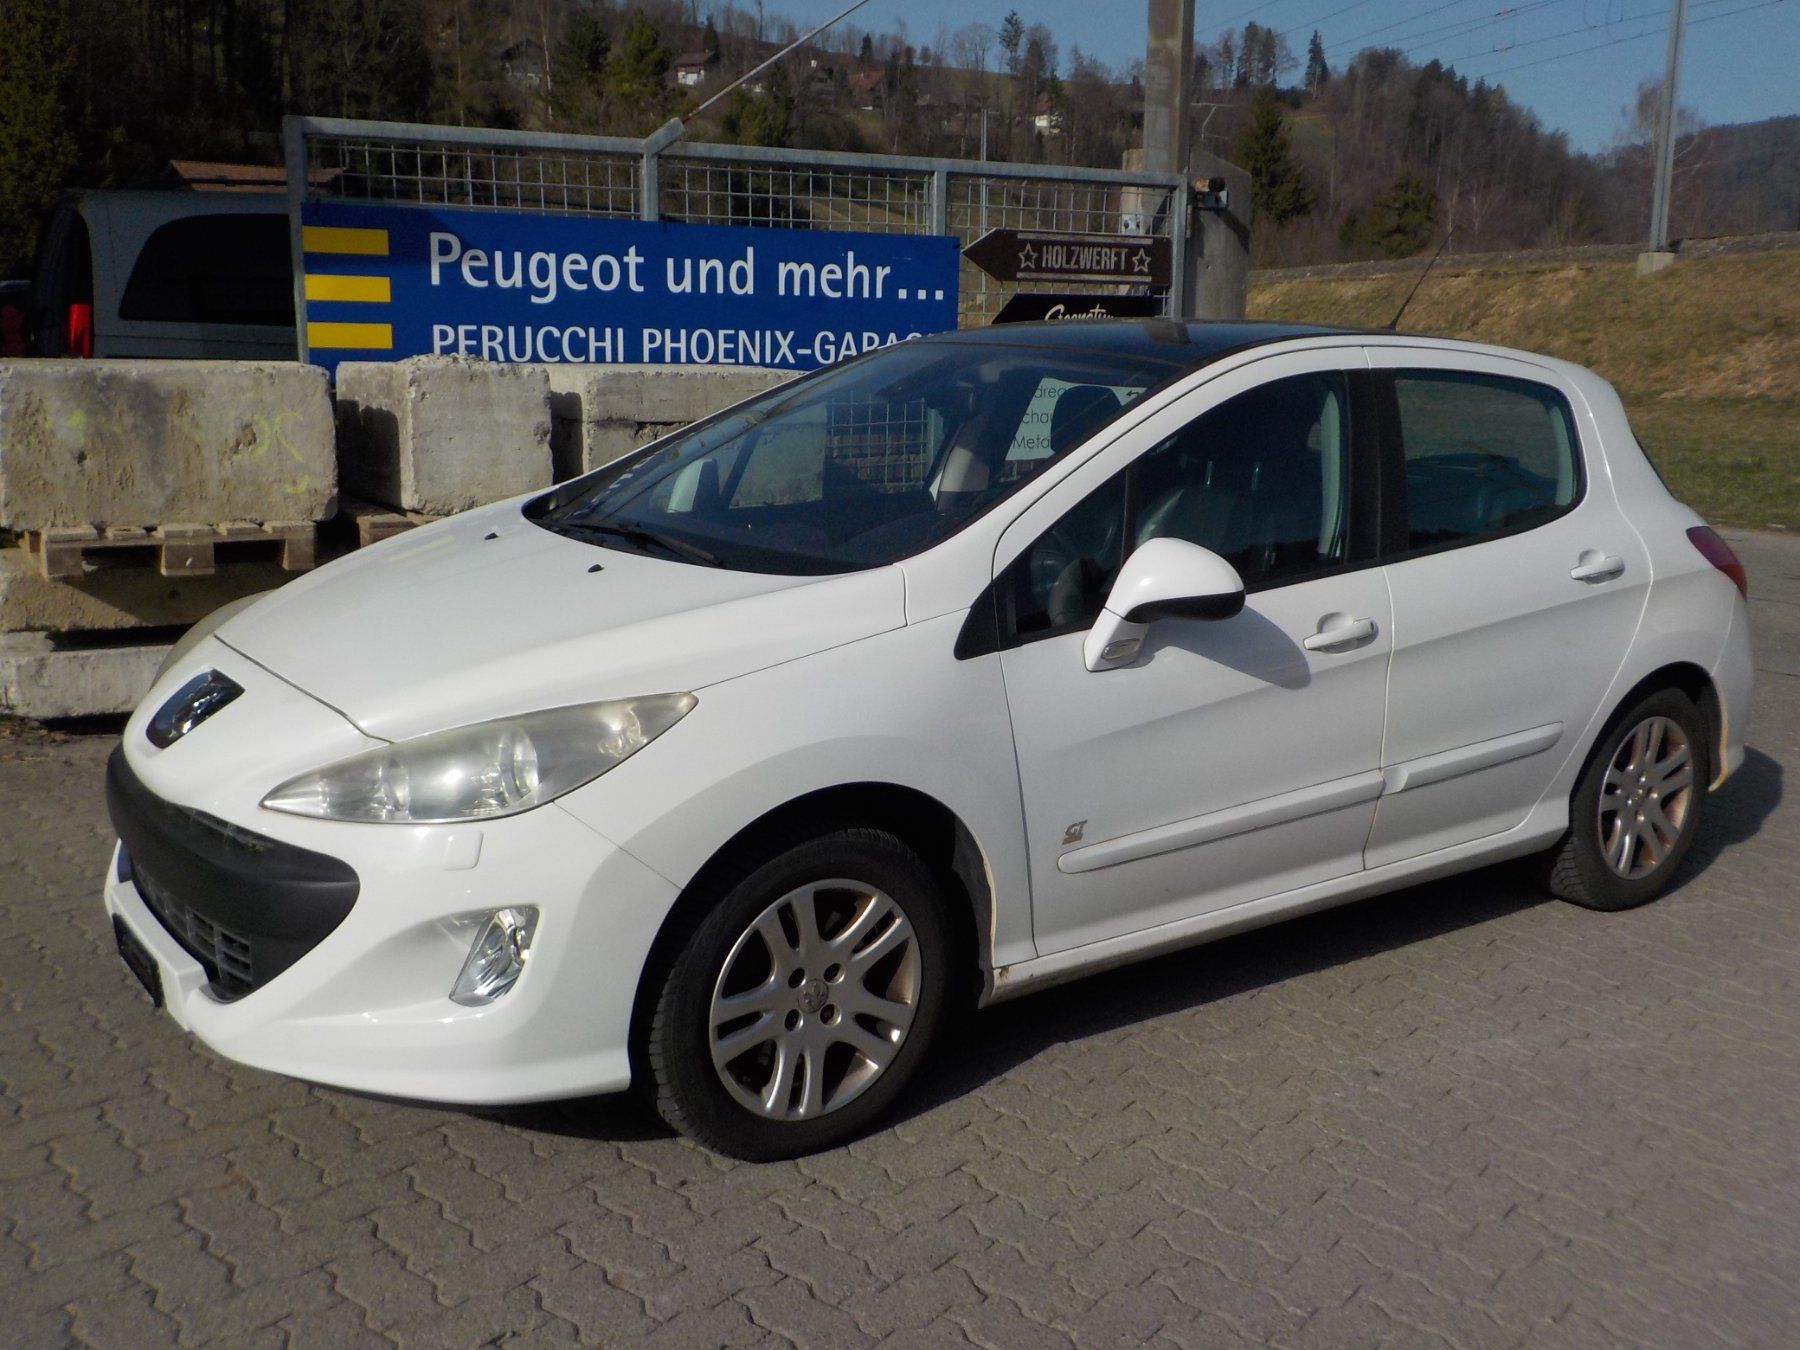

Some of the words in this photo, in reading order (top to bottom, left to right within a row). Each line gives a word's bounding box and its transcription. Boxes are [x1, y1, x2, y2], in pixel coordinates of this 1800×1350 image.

[430, 232, 645, 304] Peugeot
[666, 246, 754, 294] und
[1042, 245, 1128, 271] HOLZWERFT
[432, 324, 625, 363] PERUCCHI
